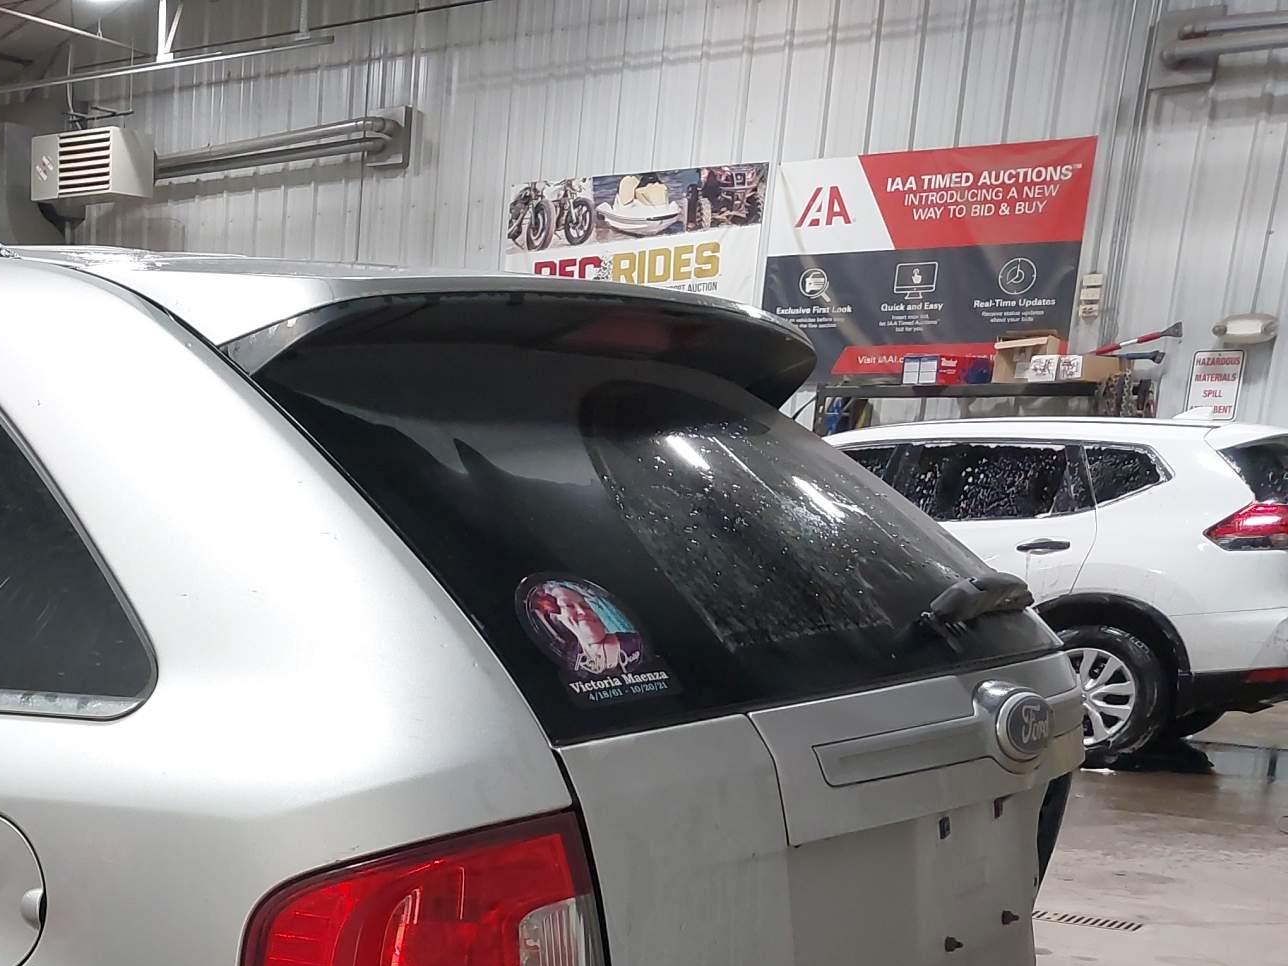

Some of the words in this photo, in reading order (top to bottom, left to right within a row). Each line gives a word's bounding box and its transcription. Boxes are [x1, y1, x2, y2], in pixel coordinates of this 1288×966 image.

[886, 176, 917, 192] IAA
[921, 172, 974, 190] TIMED
[904, 187, 1003, 206] INTRODUCING
[1007, 187, 1018, 199] A
[1023, 184, 1060, 198] NEW
[913, 206, 945, 220] WAY
[947, 204, 966, 218] TO
[971, 203, 995, 217] BID
[999, 202, 1010, 216] &
[1015, 200, 1047, 214] BUY
[612, 241, 721, 285] RIDES
[881, 303, 905, 312] Quick
[906, 302, 923, 311] and
[924, 301, 944, 311] Easy
[973, 299, 1016, 308] Real-Time
[1018, 298, 1056, 308] Updates
[776, 306, 811, 315] Exclusive
[812, 305, 830, 314] First
[832, 304, 852, 313] Look
[858, 355, 877, 365] Visit
[1196, 357, 1240, 366] HAZARDOUS
[1194, 373, 1237, 382] MATERIALS
[1202, 389, 1223, 398] SPILL
[569, 676, 622, 694] Victoria
[621, 670, 669, 684] Maenza
[589, 688, 623, 702] 4/18/61
[630, 681, 668, 694] 10/20/21
